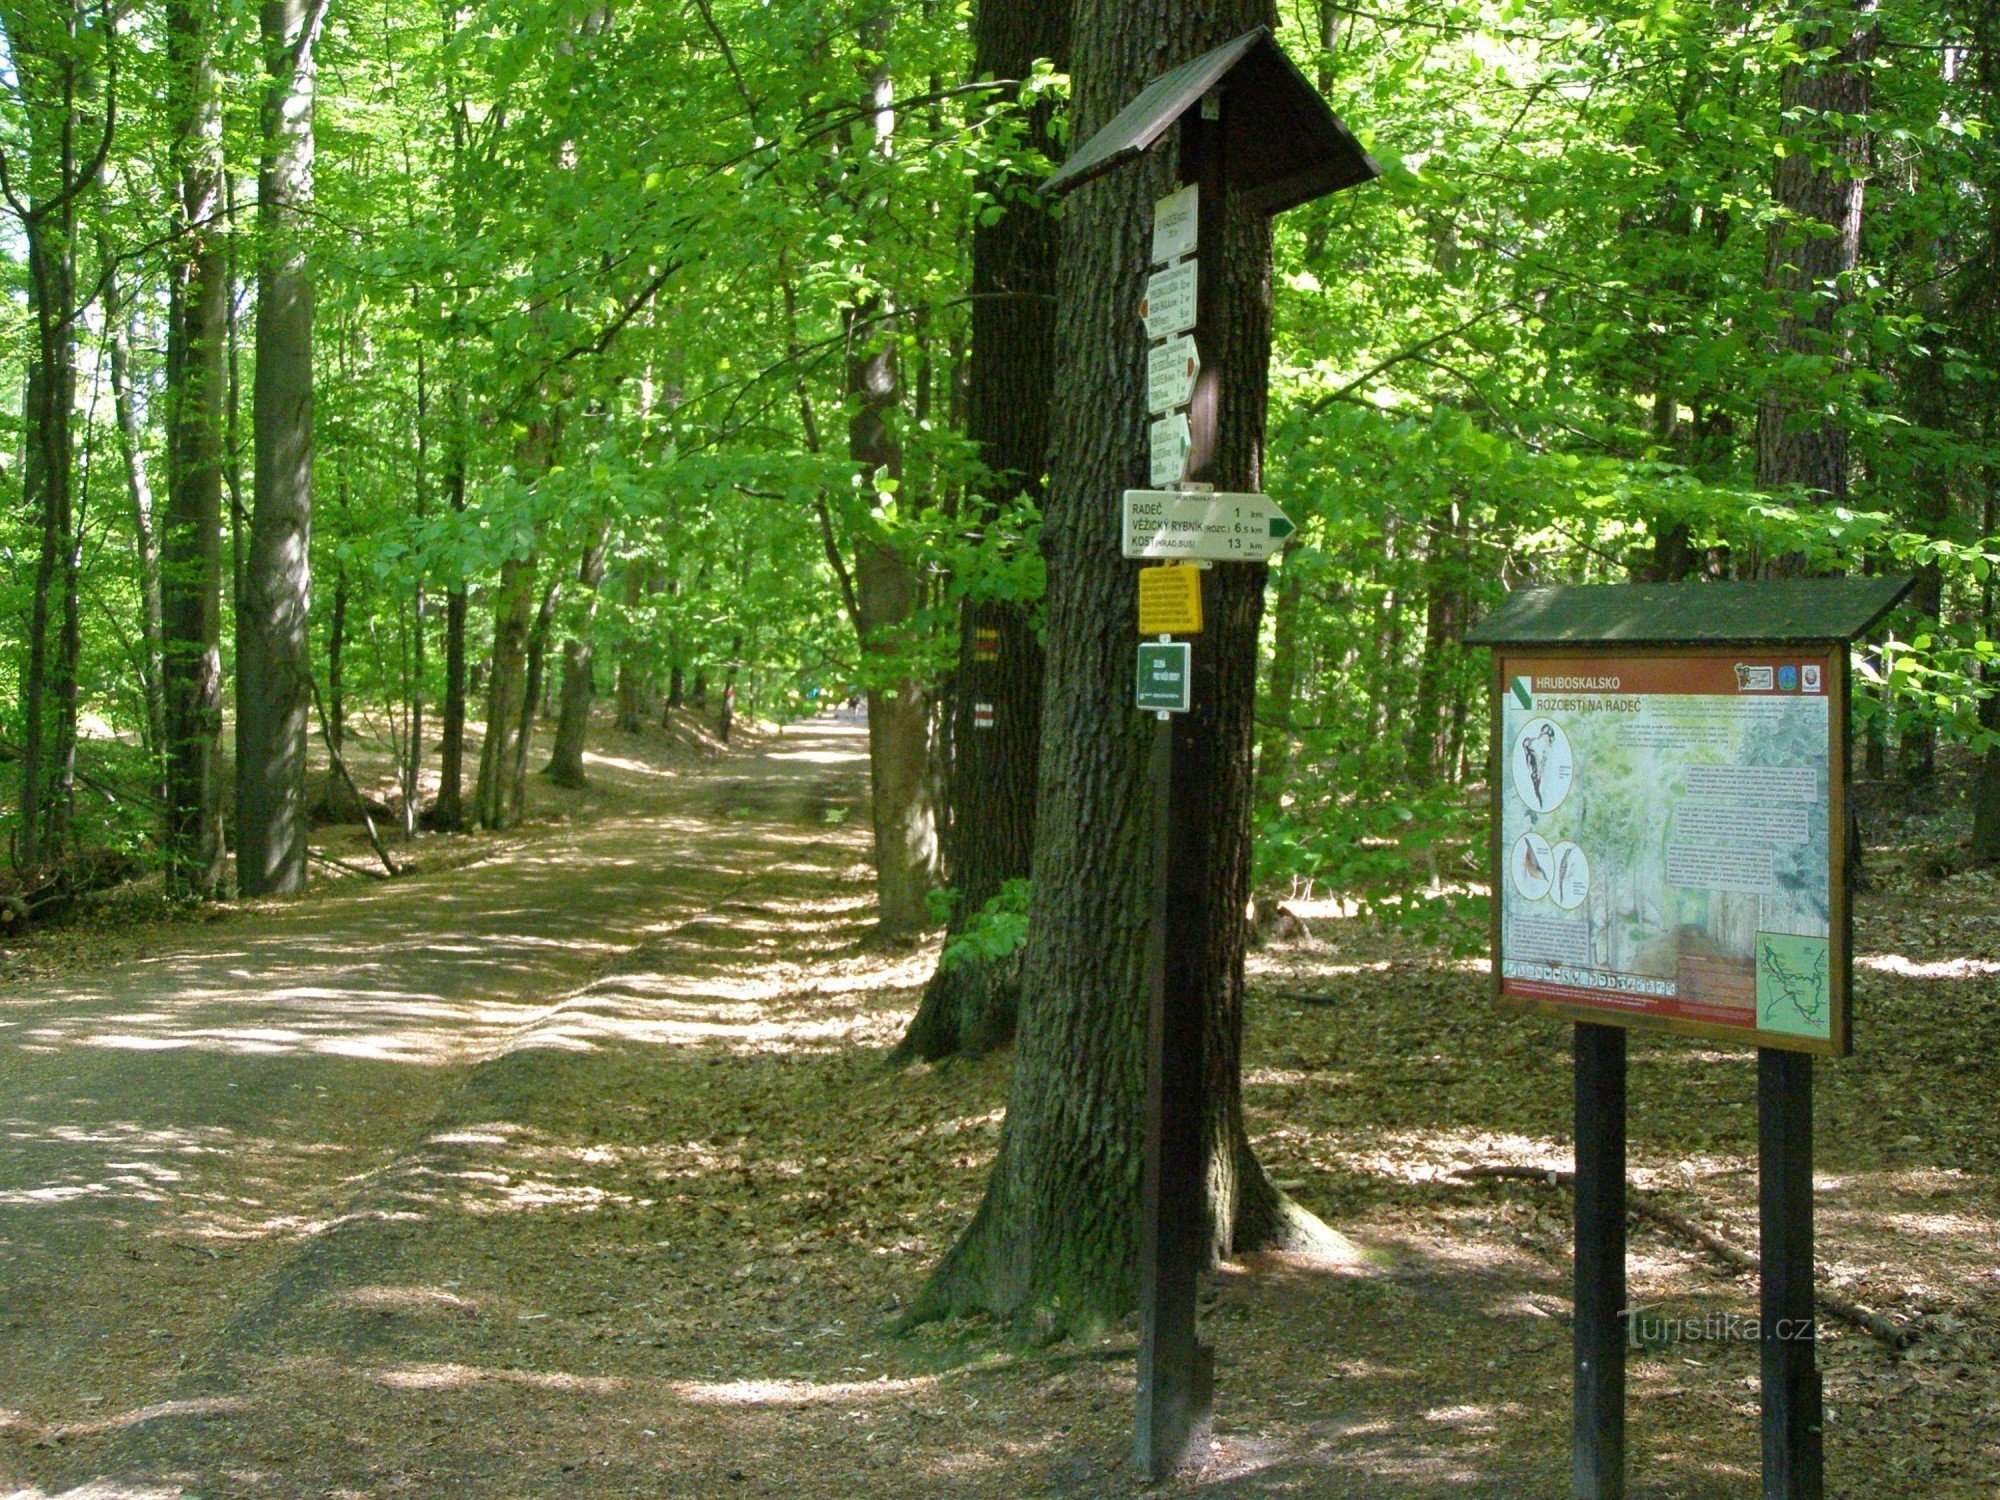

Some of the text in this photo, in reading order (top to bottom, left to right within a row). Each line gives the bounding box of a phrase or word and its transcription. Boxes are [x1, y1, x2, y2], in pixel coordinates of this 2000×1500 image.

[1132, 502, 1163, 515] RADEČ
[1234, 507, 1240, 518] 1
[1171, 519, 1203, 532] RYBNÍK
[1131, 536, 1155, 547] KOST
[1228, 538, 1241, 549] 13
[1536, 676, 1620, 689] HRUBOSKALSKO
[1536, 697, 1586, 712] ROZCESTÍ
[1588, 699, 1603, 712] NA
[1605, 697, 1642, 712] RADEČ
